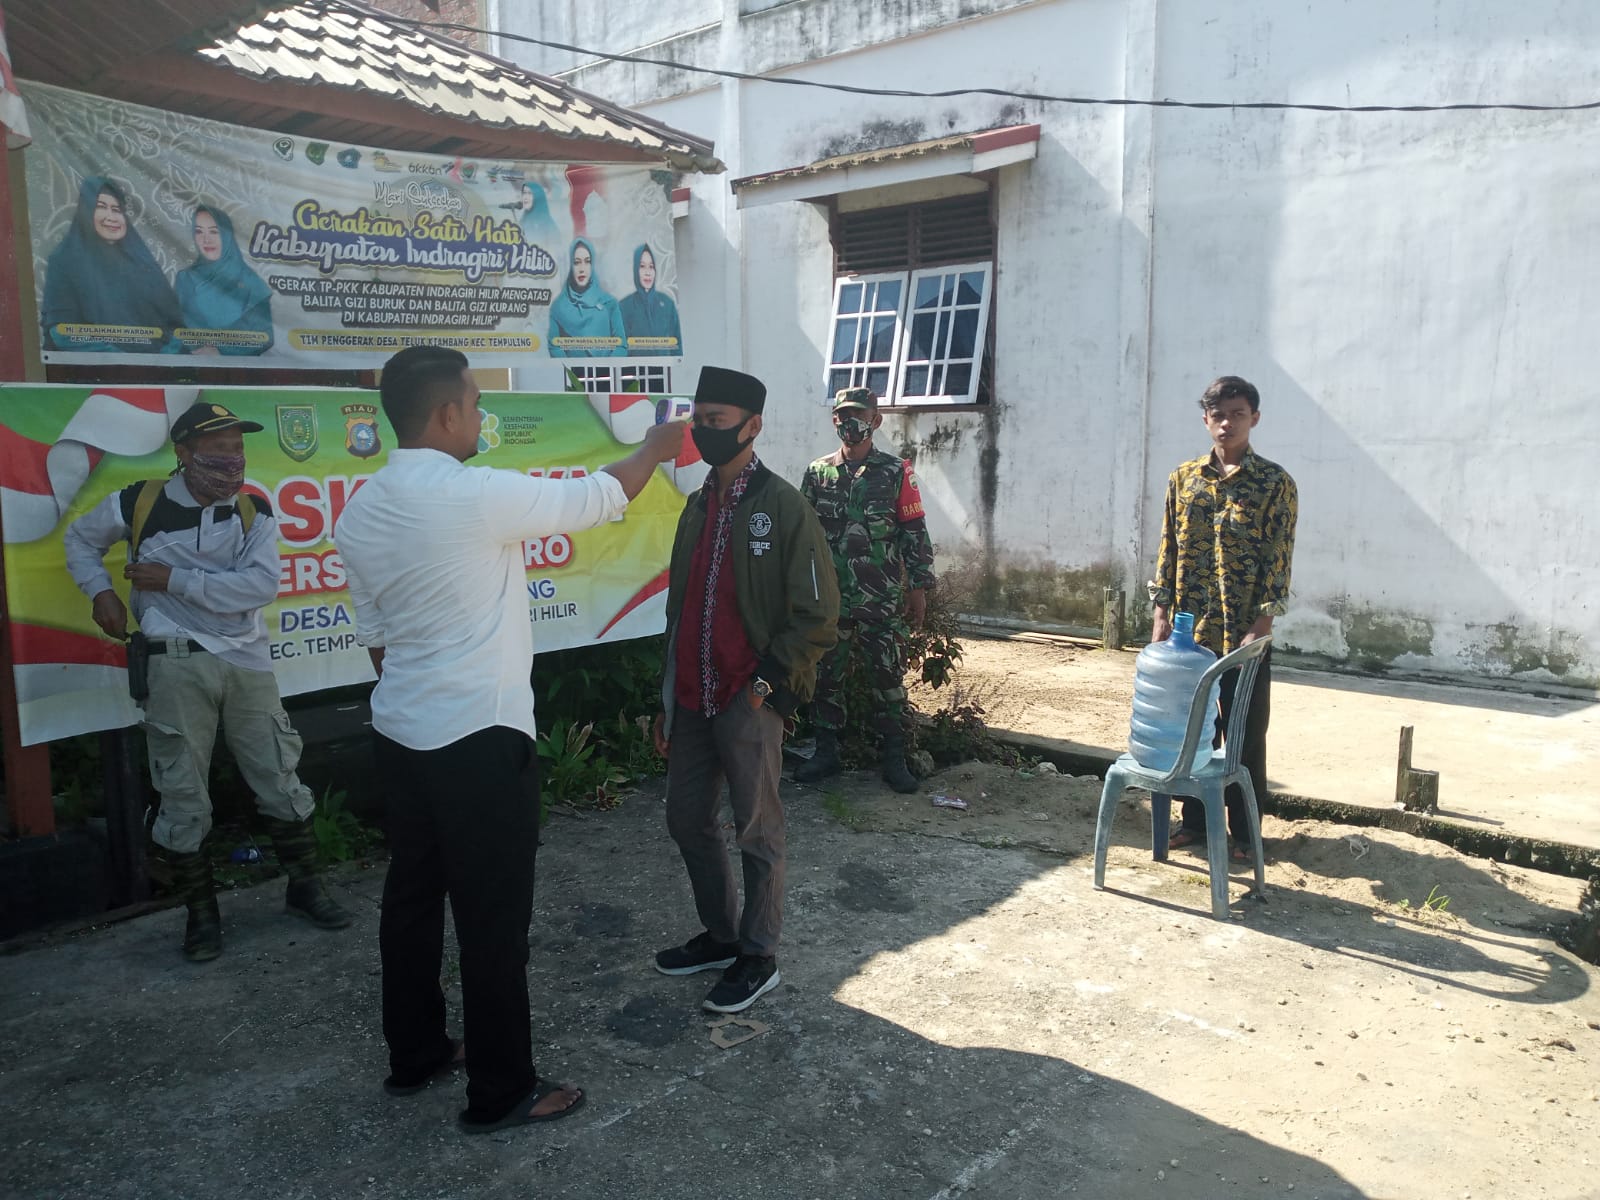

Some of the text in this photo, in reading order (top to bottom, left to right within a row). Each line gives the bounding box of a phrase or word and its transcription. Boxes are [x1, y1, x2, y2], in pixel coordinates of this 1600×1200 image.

[295, 201, 522, 245] Gerakan Satu Hati
[251, 223, 553, 279] Kabupaten Indragiri Hilir
[320, 280, 360, 294] TP-PKK
[362, 282, 424, 297] KABUPATEN
[426, 286, 477, 299] INDRAGIRI
[478, 287, 500, 300] HILIR
[501, 288, 550, 301] MENGATASI
[303, 295, 527, 313] BALITA GIZI BURUK DAN BALITA GIZI KURANG
[343, 311, 355, 323] DI
[358, 312, 419, 325] KABUPATEN
[421, 314, 469, 325] INDRAGIRI
[300, 335, 319, 345] TIM
[322, 335, 374, 346] PENGGERAK
[377, 336, 398, 346] DESA
[400, 336, 425, 347] TELUK
[488, 337, 531, 347] TEMPULING
[345, 405, 374, 414] RIAU
[525, 534, 570, 566] RO
[281, 579, 556, 633] DESA NG
[269, 642, 302, 661] EC.
[304, 633, 367, 656] TEMP
[541, 602, 578, 621] HILIR
